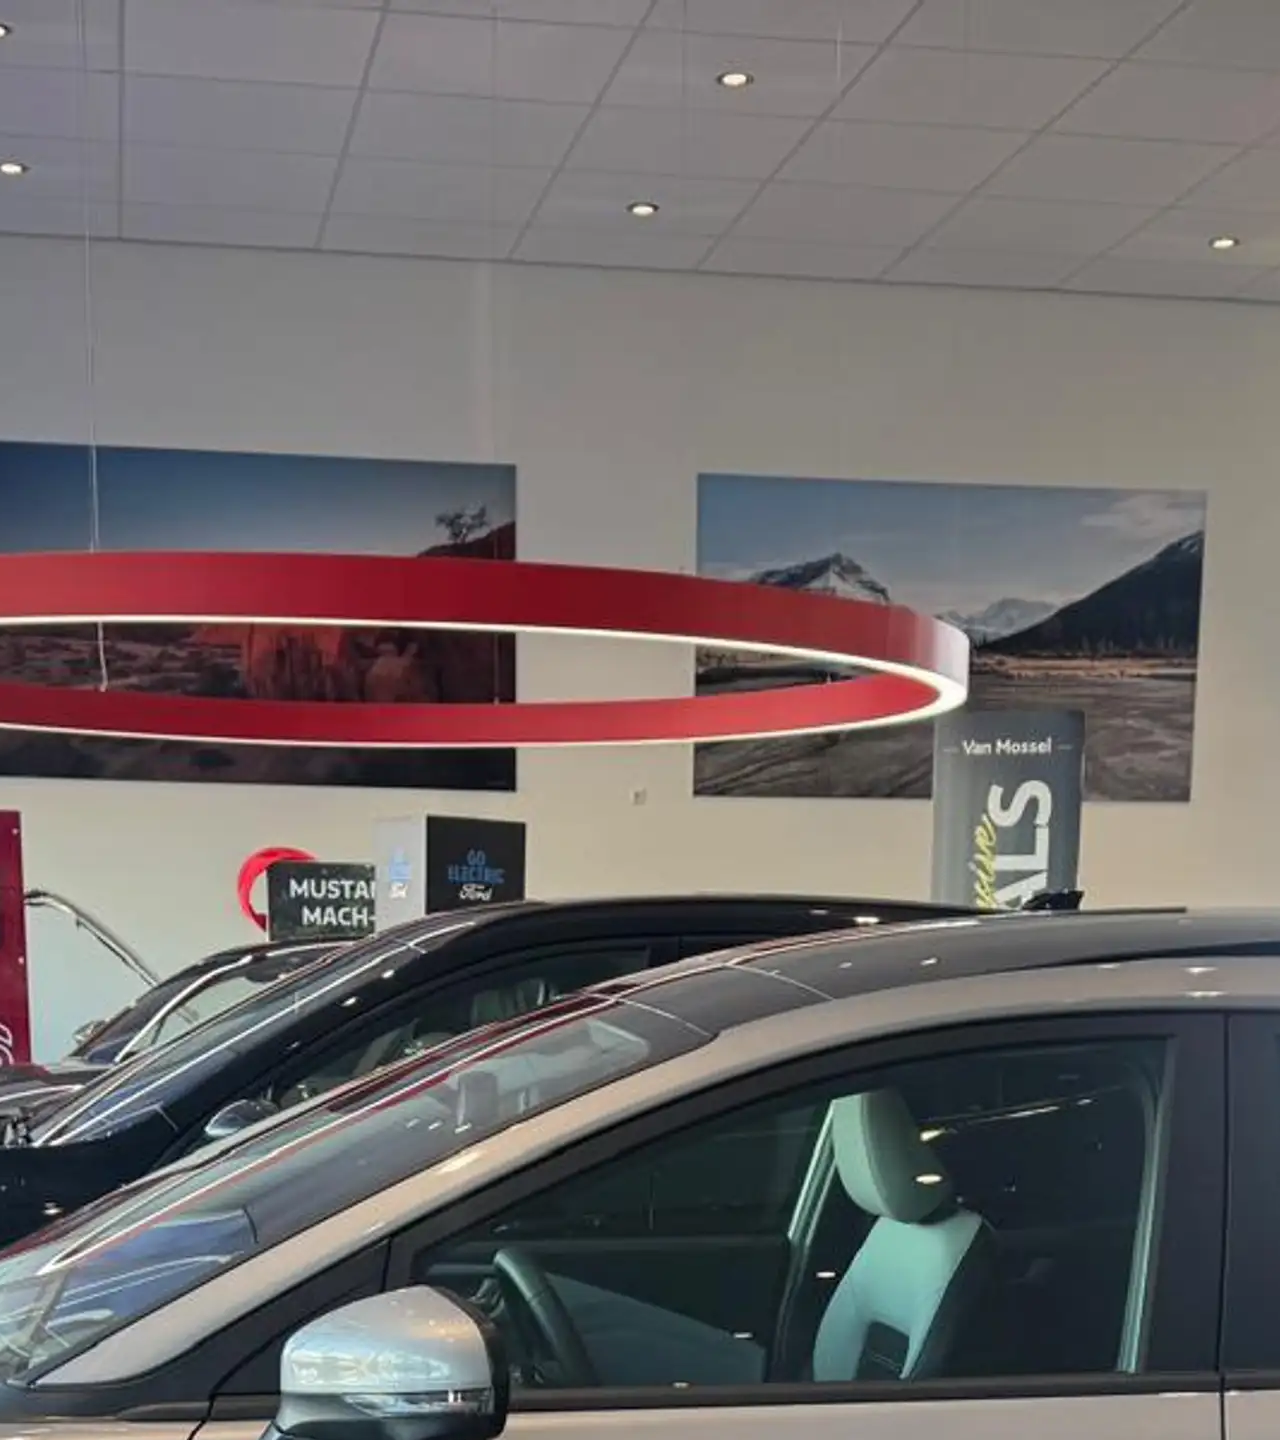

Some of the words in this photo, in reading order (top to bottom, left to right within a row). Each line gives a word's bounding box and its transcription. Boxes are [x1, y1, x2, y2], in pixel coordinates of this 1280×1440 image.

[962, 738, 991, 755] Van
[996, 736, 1052, 755] Mossel
[466, 848, 486, 867] GO
